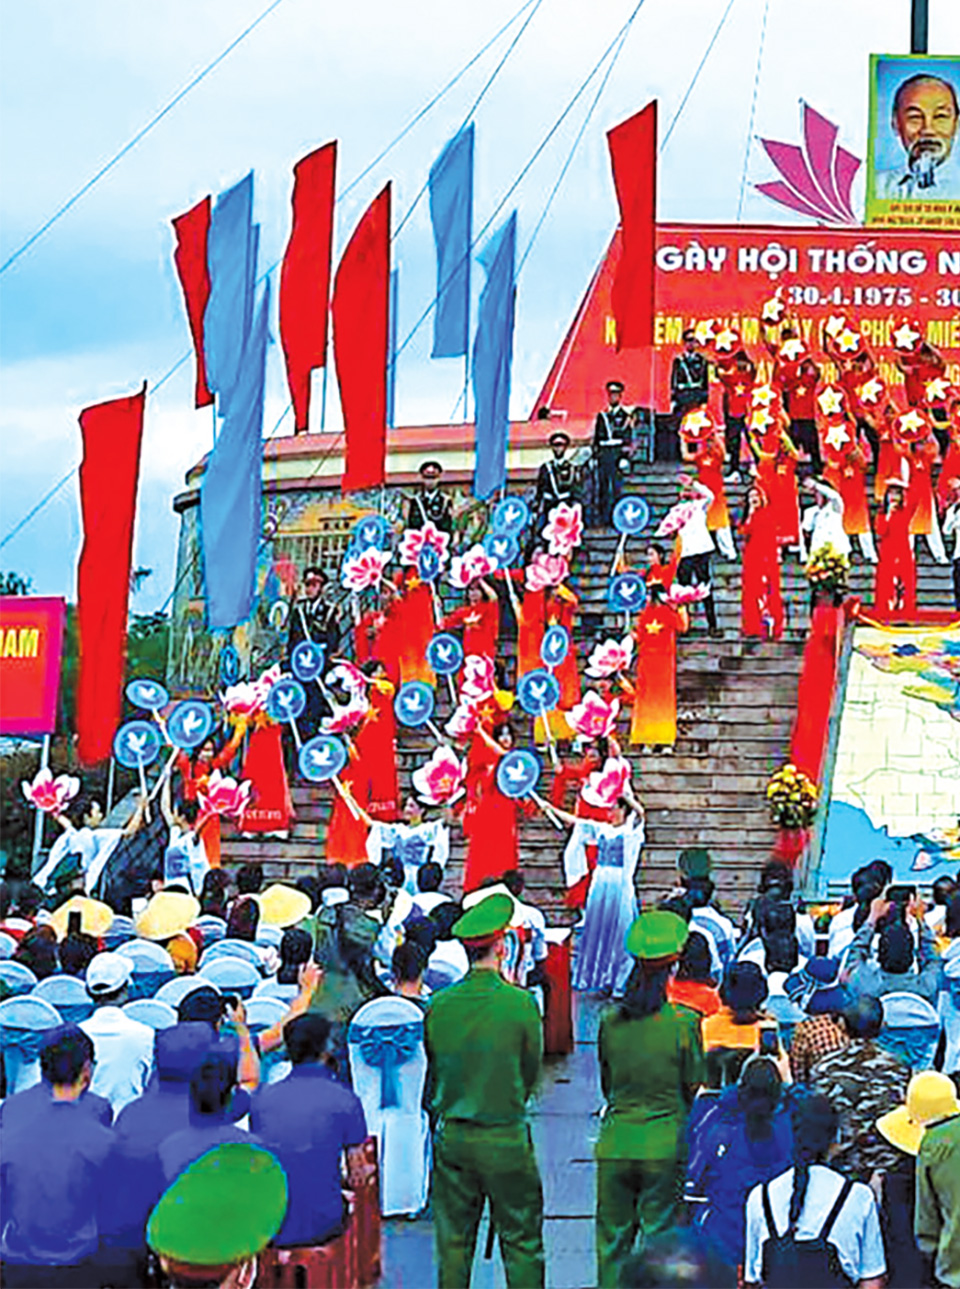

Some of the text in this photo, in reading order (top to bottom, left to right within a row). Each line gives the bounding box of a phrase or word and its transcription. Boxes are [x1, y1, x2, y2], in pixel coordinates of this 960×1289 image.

[655, 241, 727, 272] GÀY
[737, 242, 798, 280] HỘI
[808, 241, 928, 274] THỐNG
[0, 629, 39, 658] AM
